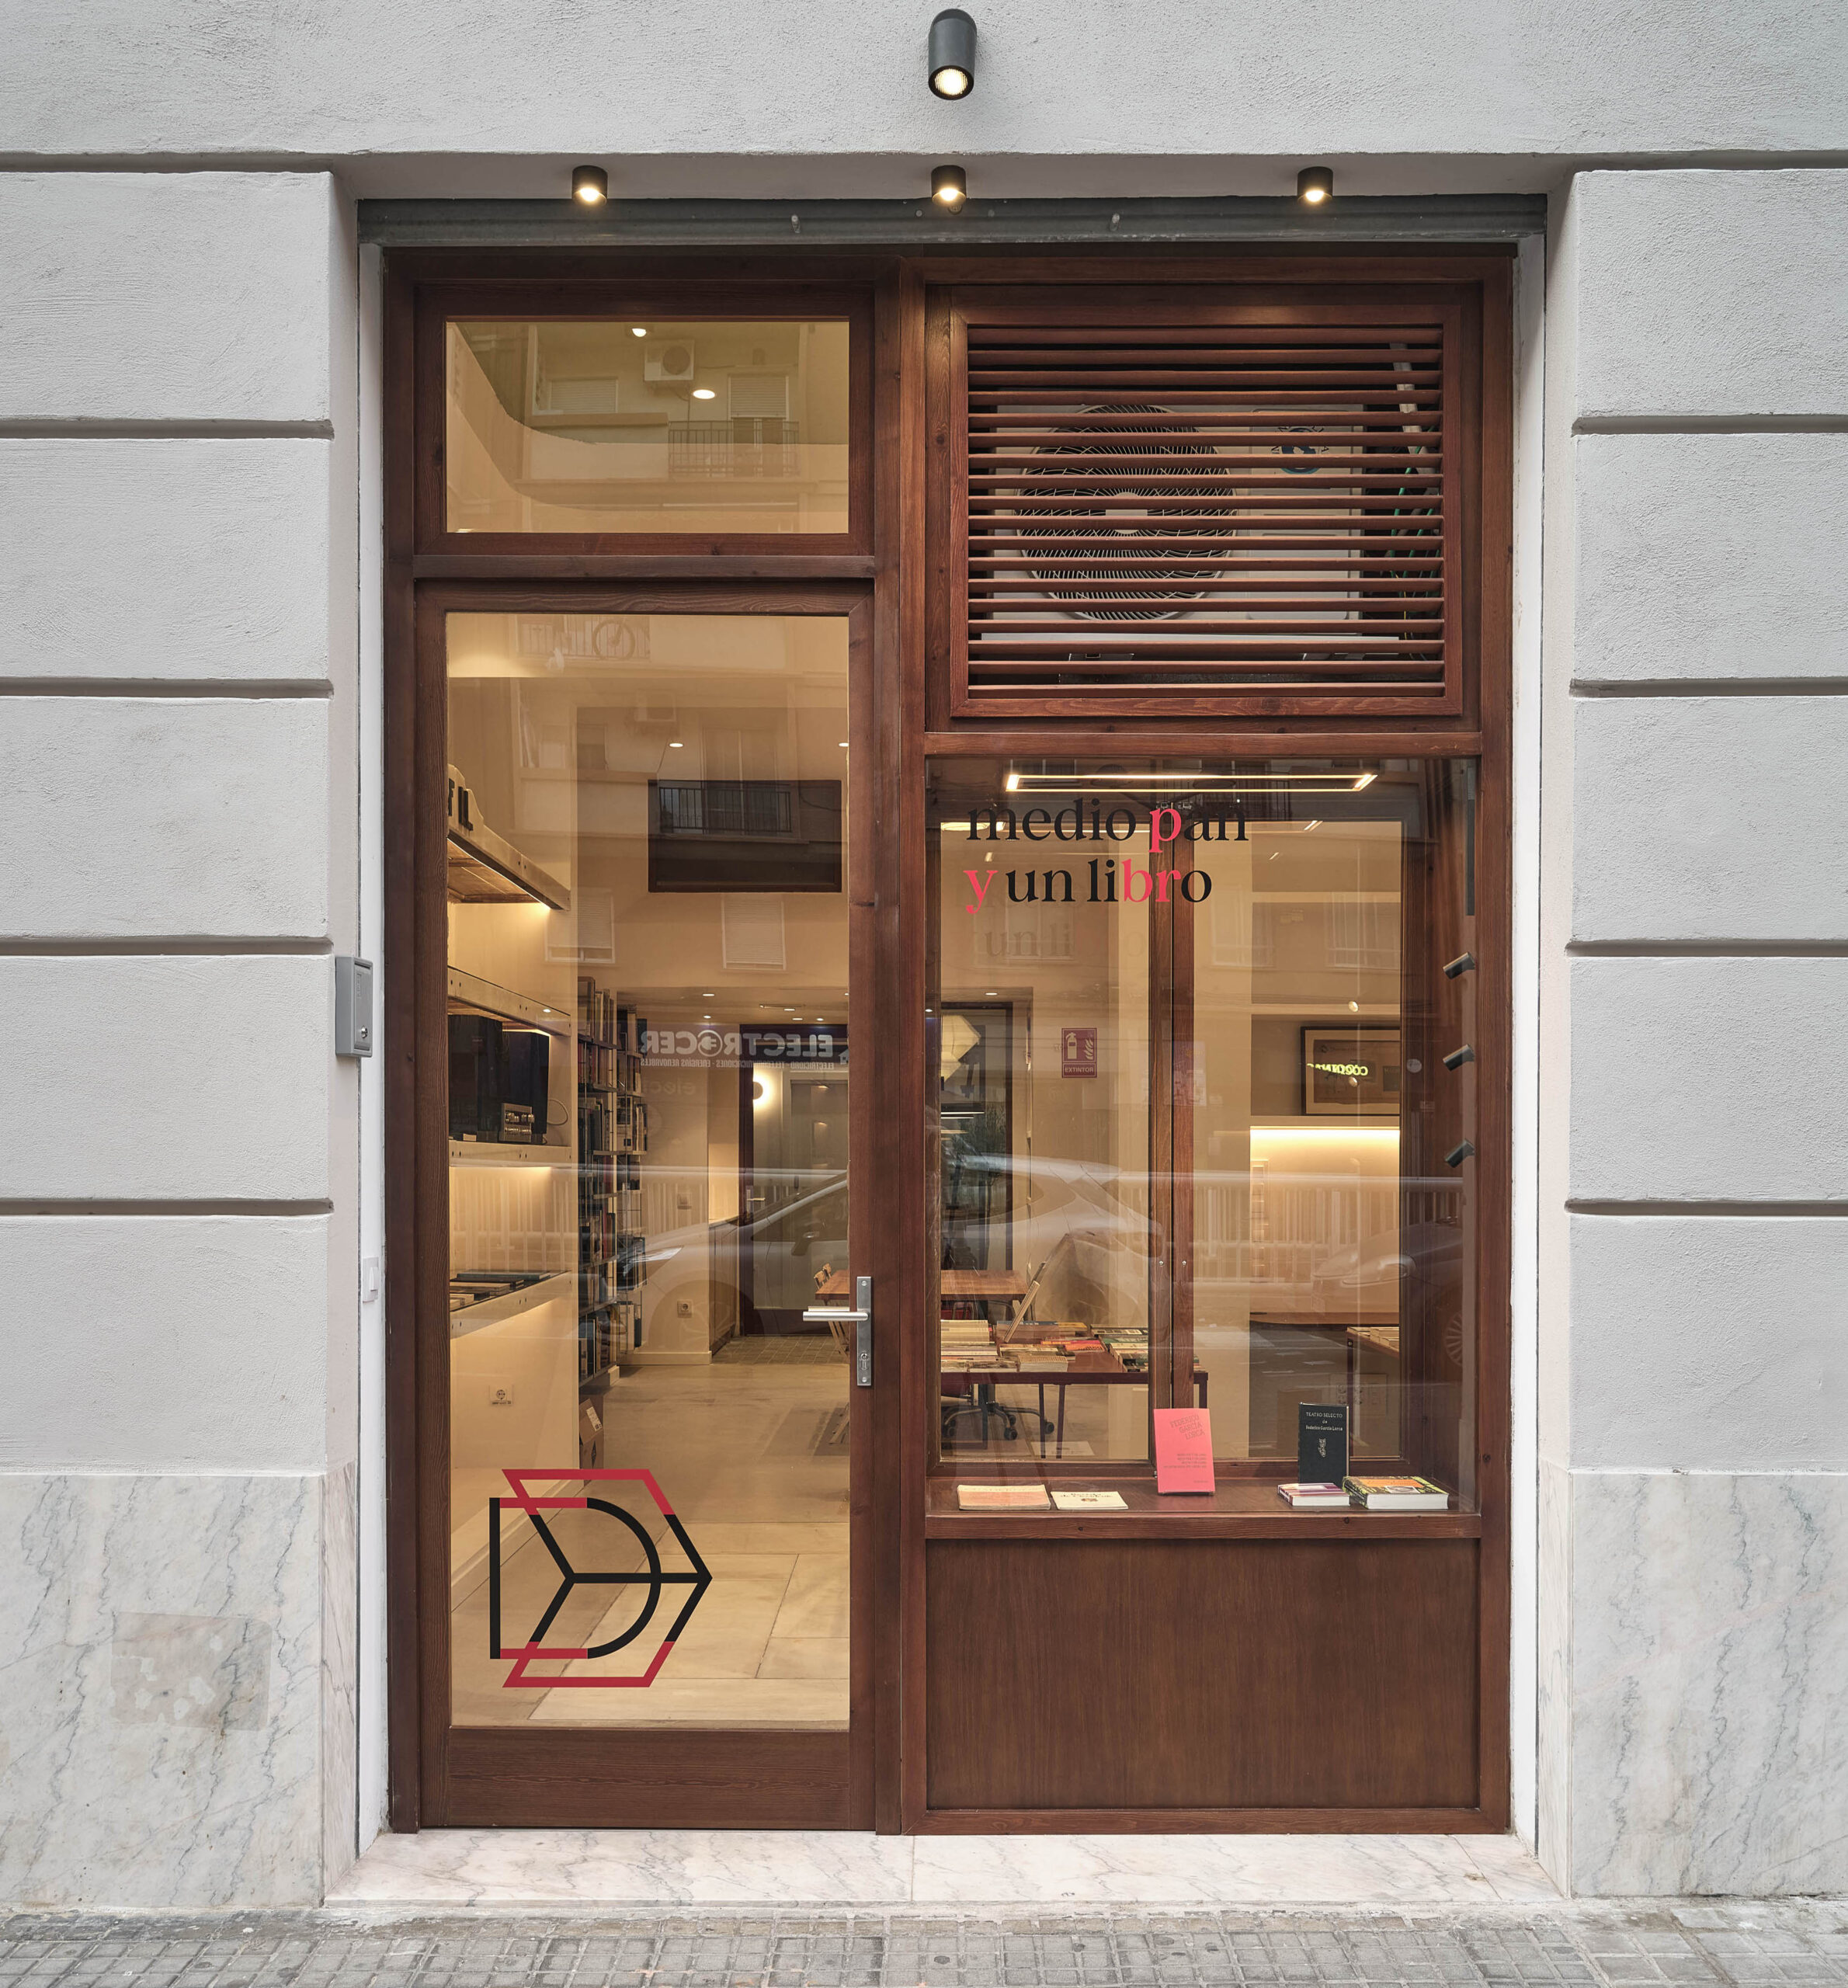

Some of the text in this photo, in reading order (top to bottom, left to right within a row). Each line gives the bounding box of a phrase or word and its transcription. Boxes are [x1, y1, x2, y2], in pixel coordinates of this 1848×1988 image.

[966, 798, 1249, 853] medio pan
[964, 858, 1212, 913] y un libro
[1170, 1414, 1200, 1429] FEDERICO
[1184, 1428, 1205, 1441] LORCA
